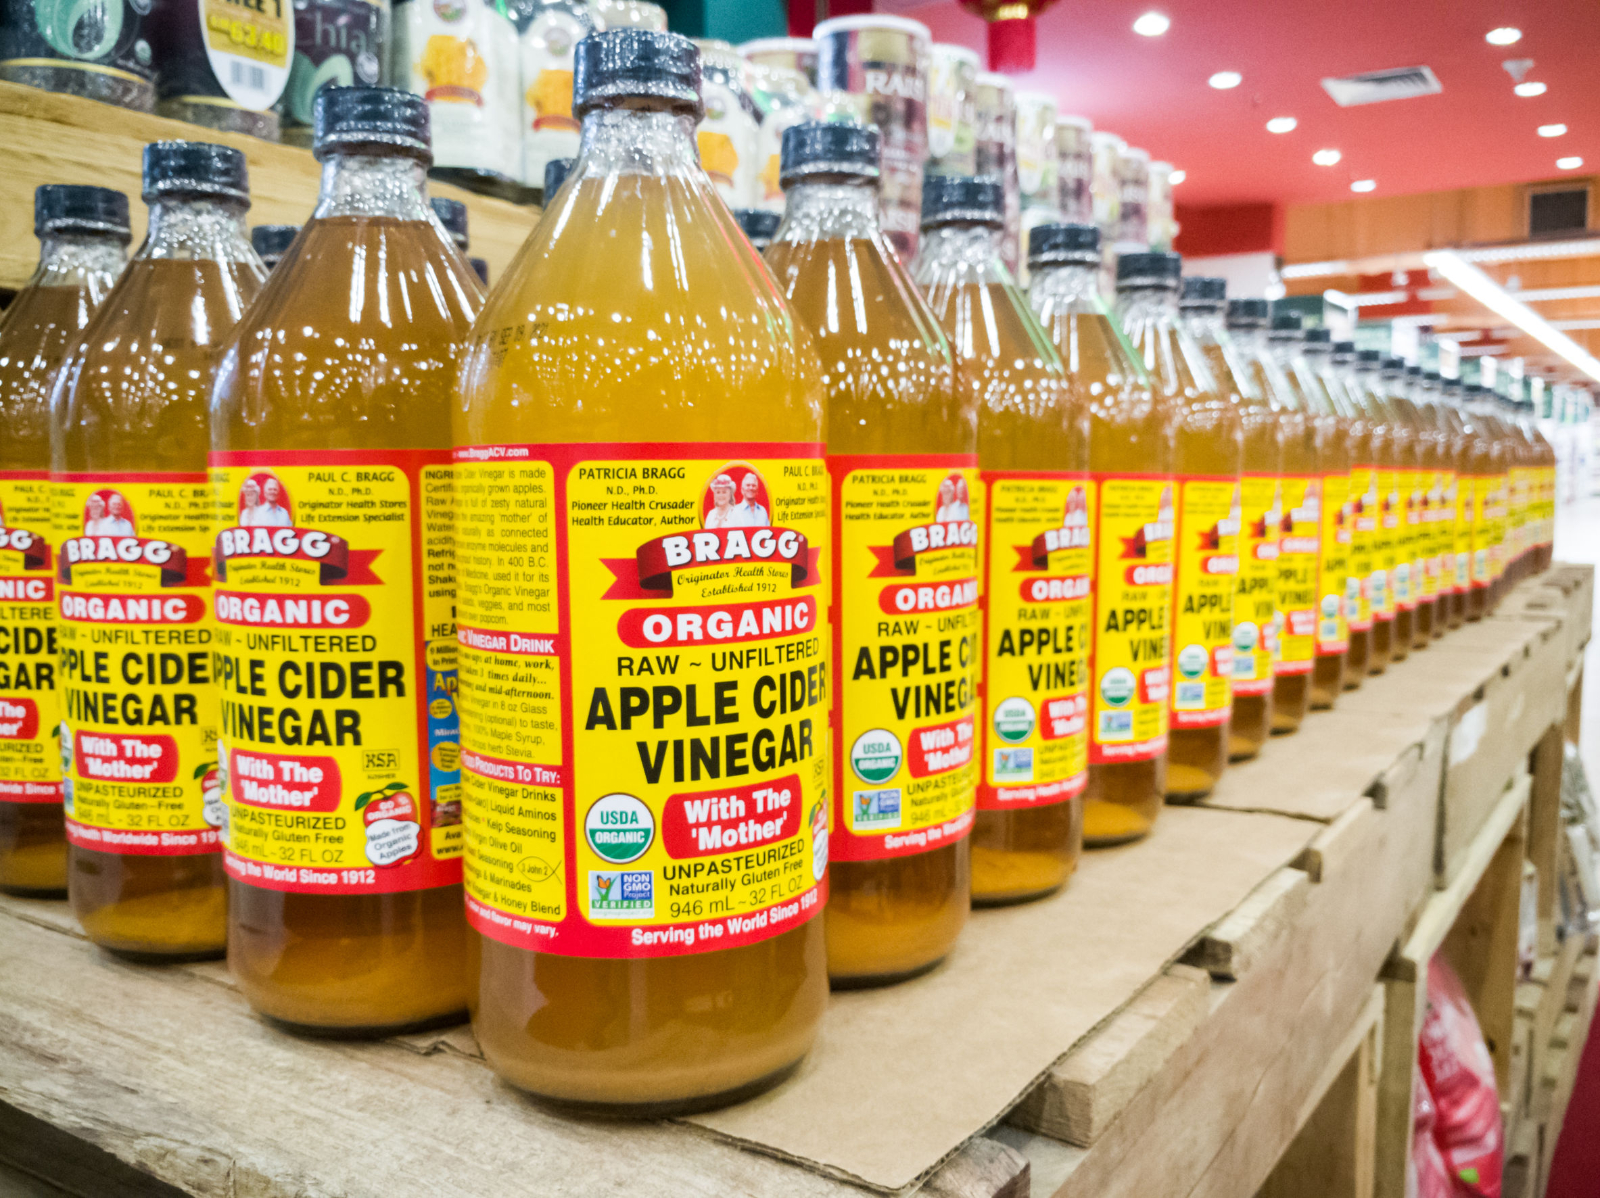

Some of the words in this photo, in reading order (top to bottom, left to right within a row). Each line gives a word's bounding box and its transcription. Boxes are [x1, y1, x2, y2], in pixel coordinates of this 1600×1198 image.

[308, 472, 336, 483] PAUL
[341, 472, 353, 483] C.
[356, 471, 395, 483] BRAGG
[519, 467, 546, 479] made
[579, 468, 637, 480] PATRICIA
[642, 467, 686, 479] BRAGG
[784, 466, 802, 477] PAUL
[852, 475, 895, 485] PATRICIA
[898, 474, 927, 484] BRAGG
[488, 485, 510, 497] grown
[513, 483, 546, 498] apples.
[633, 486, 658, 496] Ph.D.
[298, 500, 343, 511] Originator
[347, 500, 376, 510] Health
[379, 500, 408, 510] Stores
[515, 497, 547, 508] natural
[572, 501, 608, 511] Pioneer
[612, 500, 645, 510] Health
[649, 500, 695, 510] Crusader
[318, 513, 360, 523] Extension
[363, 512, 406, 523] Specialist
[572, 515, 605, 526] Health
[608, 515, 657, 527] Educator,
[660, 514, 696, 525] Author
[501, 527, 549, 539] connected
[66, 537, 172, 564] BRAGG
[222, 528, 332, 558] BRAGG
[488, 541, 527, 553] molecules
[531, 542, 549, 553] and
[662, 529, 799, 567] BRAGG
[508, 556, 524, 567] 400
[528, 556, 548, 568] B.C.
[493, 570, 512, 582] used
[522, 571, 535, 582] for
[538, 571, 550, 583] its
[677, 570, 730, 586] Originator
[733, 566, 765, 578] Health
[483, 583, 512, 597] Organic
[514, 585, 550, 600] Vinegar
[702, 583, 753, 598] Established
[757, 582, 777, 593] 1912
[62, 595, 187, 621] ORGANIC
[217, 595, 350, 626] ORGANIC
[508, 600, 524, 610] and
[527, 600, 550, 612] most
[1018, 606, 1050, 622] RAW
[642, 602, 809, 643] ORGANIC
[877, 620, 919, 637] RAW
[91, 629, 212, 645] UNFILTERED
[247, 633, 377, 653] UNFILTERED
[510, 633, 555, 654] DRINK
[996, 625, 1074, 657] APPLE
[524, 659, 555, 671] work,
[617, 655, 680, 677] RAW
[711, 637, 820, 672] UNFILTERED
[852, 640, 952, 681] APPLE
[278, 660, 406, 700] CIDER
[487, 670, 509, 682] times
[585, 680, 739, 731] APPLE
[753, 662, 826, 719] CIDER
[65, 686, 198, 726] VINEGAR
[520, 702, 548, 715] Glass
[221, 699, 362, 746] VINEGAR
[490, 728, 513, 742] Maple
[920, 727, 955, 751] With
[81, 735, 118, 757] With
[122, 739, 162, 758] The
[636, 718, 813, 784] VINEGAR
[863, 742, 892, 755] USDA
[85, 757, 158, 779] 'Mother'
[236, 755, 275, 781] With
[279, 760, 324, 783] The
[241, 782, 319, 807] 'Mother'
[488, 780, 519, 799] Vinegar
[522, 788, 557, 802] Drinks
[490, 801, 515, 816] Liquid
[517, 805, 557, 821] Aminos
[684, 795, 746, 825] With
[752, 788, 792, 813] The
[231, 805, 346, 830] UNPASTEURIZED
[600, 811, 639, 825] USDA
[272, 829, 311, 844] Gluten
[315, 832, 344, 844] Free
[486, 817, 503, 833] Kelp
[505, 822, 556, 842] Seasoning
[594, 831, 645, 844] ORGANIC
[692, 811, 788, 851] 'Mother'
[489, 836, 508, 852] Olive
[510, 841, 523, 854] Oil
[884, 832, 927, 849] Serving
[279, 847, 295, 861] 32
[300, 848, 316, 862] FL
[322, 850, 344, 863] OZ
[663, 839, 805, 881] UNPASTEURIZED
[263, 865, 298, 882] World
[300, 869, 338, 884] Since
[341, 870, 376, 884] 1912
[490, 872, 532, 893] Marinades
[623, 874, 650, 883] NON
[669, 877, 737, 896] Naturally
[740, 865, 780, 887] Gluten
[783, 858, 804, 875] Free
[623, 882, 651, 892] GMO
[624, 890, 651, 900] Project
[500, 894, 528, 913] Honey
[531, 901, 561, 916] Blend
[594, 900, 651, 910] VERIFIED
[670, 900, 703, 918] 946
[709, 896, 733, 914] mL
[749, 887, 767, 906] 32
[771, 882, 785, 901] FL
[788, 875, 803, 895] OZ
[631, 928, 695, 946] Serving
[699, 923, 724, 939] the
[727, 912, 768, 936] World
[770, 902, 799, 924] Since
[800, 889, 818, 910] 1912
